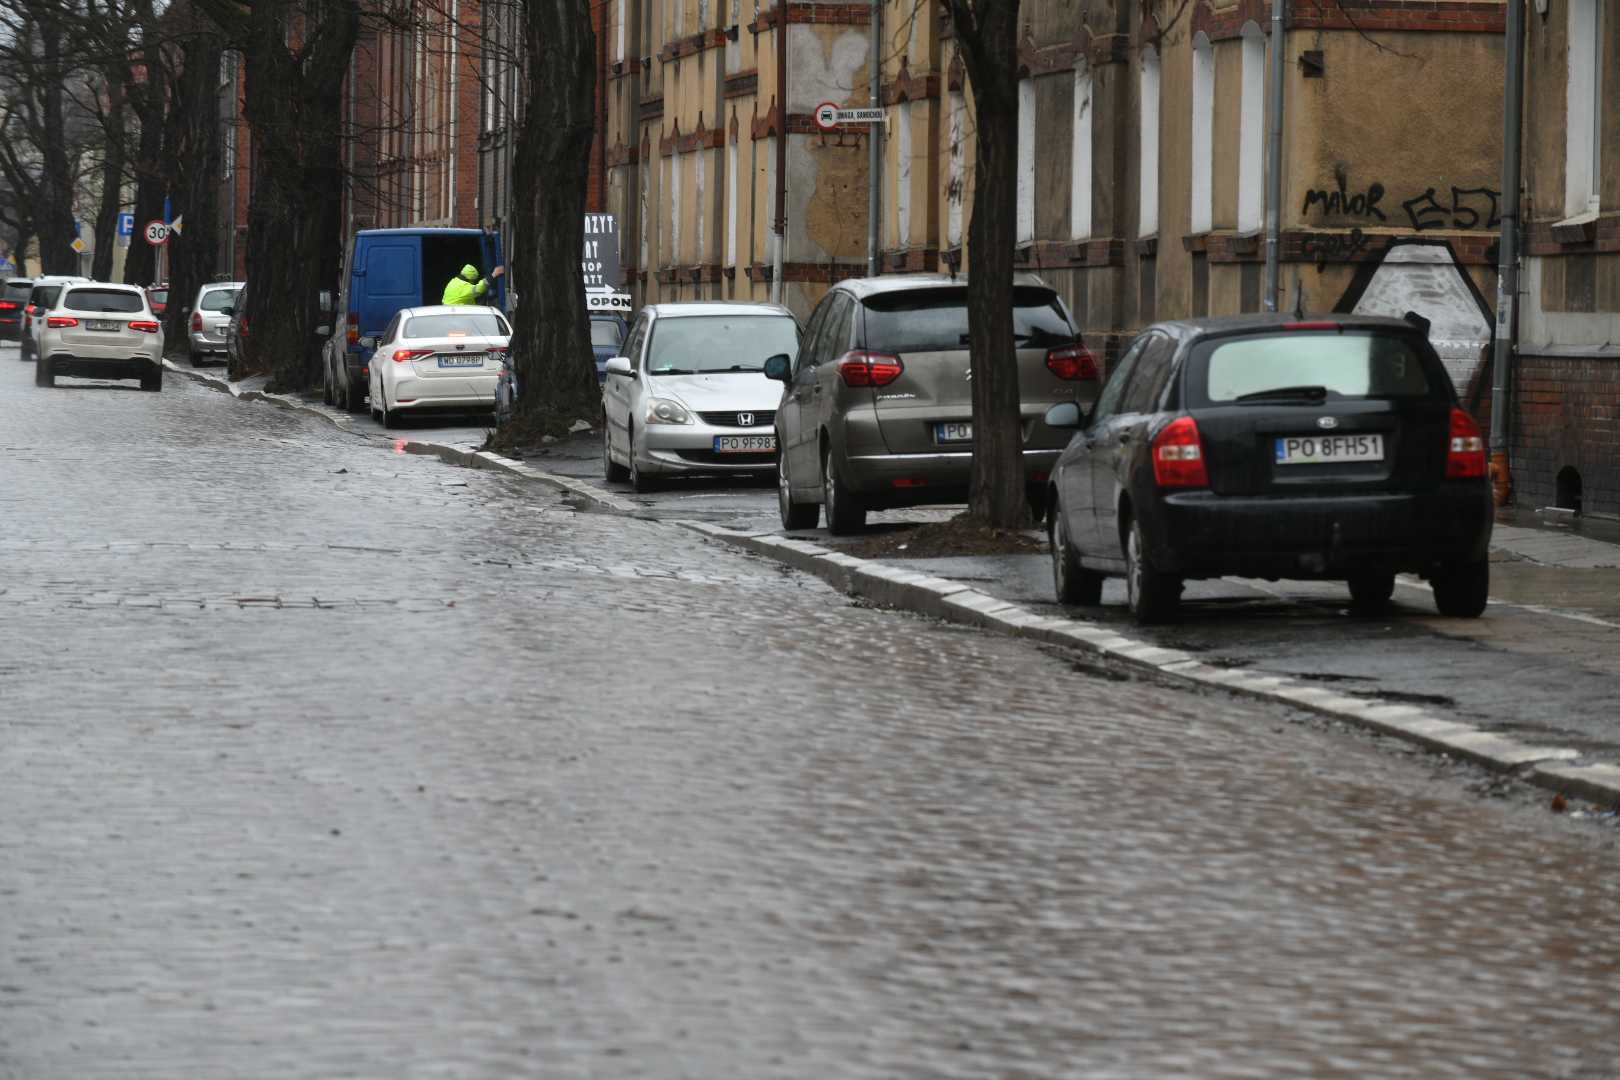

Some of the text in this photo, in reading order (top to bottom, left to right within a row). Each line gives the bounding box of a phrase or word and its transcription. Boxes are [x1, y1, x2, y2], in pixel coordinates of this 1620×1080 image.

[149, 227, 165, 239] 30
[444, 356, 454, 365] WD
[456, 356, 481, 365] 0798P
[947, 424, 966, 439] PO
[721, 438, 739, 449] PO
[742, 437, 776, 449] 9F983
[1287, 436, 1378, 457] PO 8FH51
